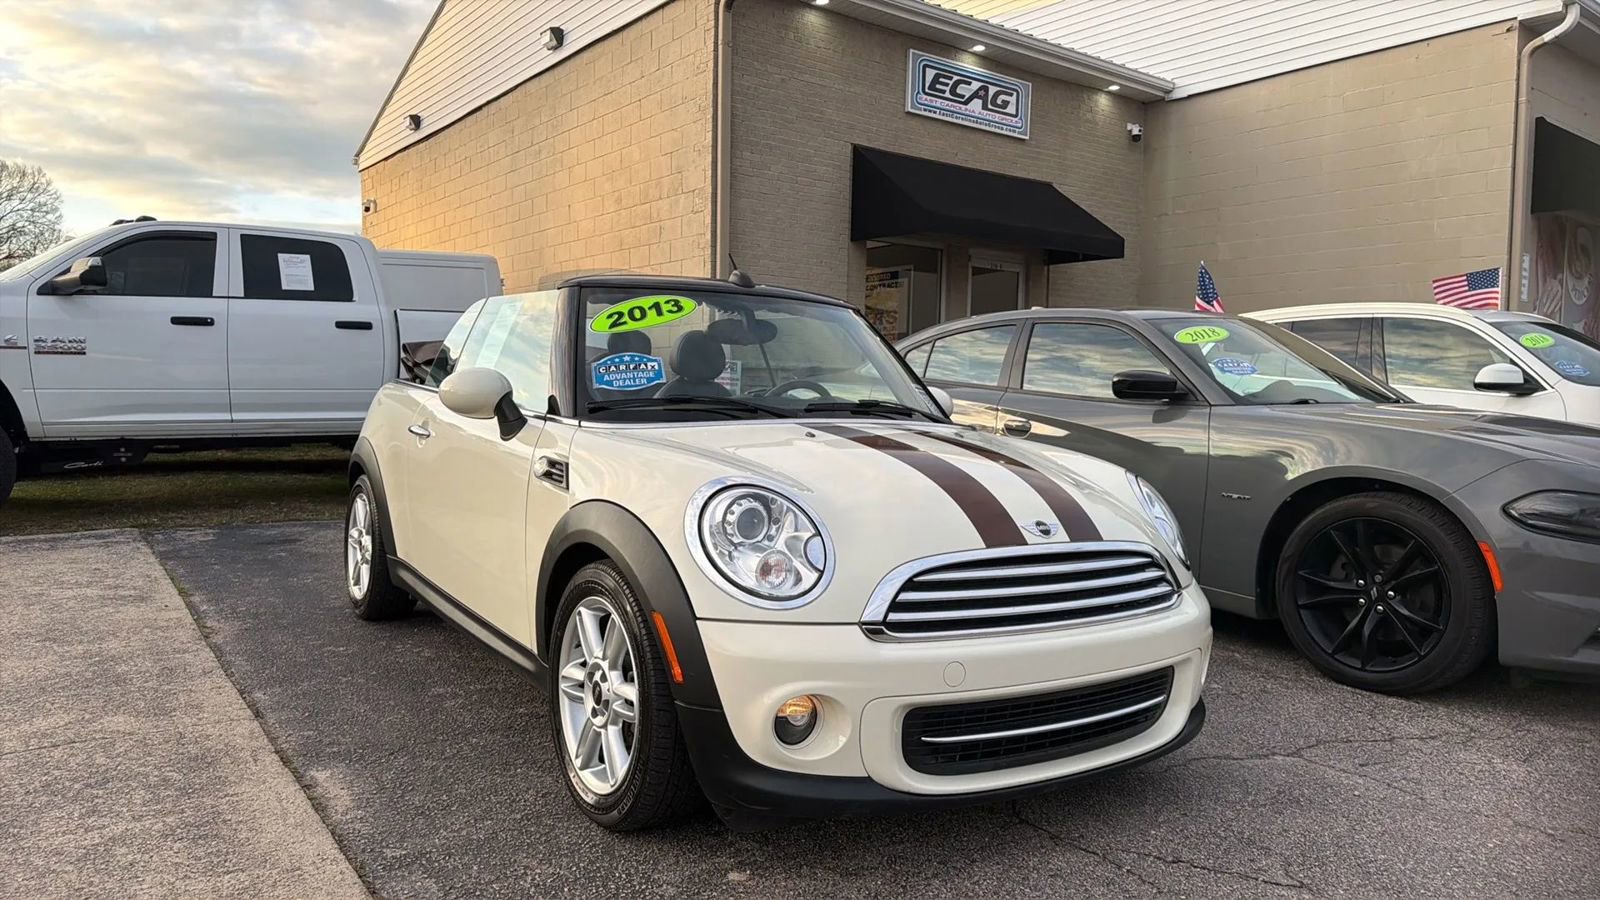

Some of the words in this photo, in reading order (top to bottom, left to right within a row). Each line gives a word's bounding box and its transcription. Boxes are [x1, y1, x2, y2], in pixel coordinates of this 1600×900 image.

[927, 72, 1014, 111] ECAG
[940, 101, 977, 114] CAROLINA
[978, 110, 997, 120] AUTO
[605, 298, 684, 330] 2013
[33, 336, 87, 344] RAM
[1185, 328, 1220, 342] 2018
[599, 362, 658, 374] CARFAX
[603, 371, 656, 382] ADVANTAGE
[613, 378, 648, 388] DEALER
